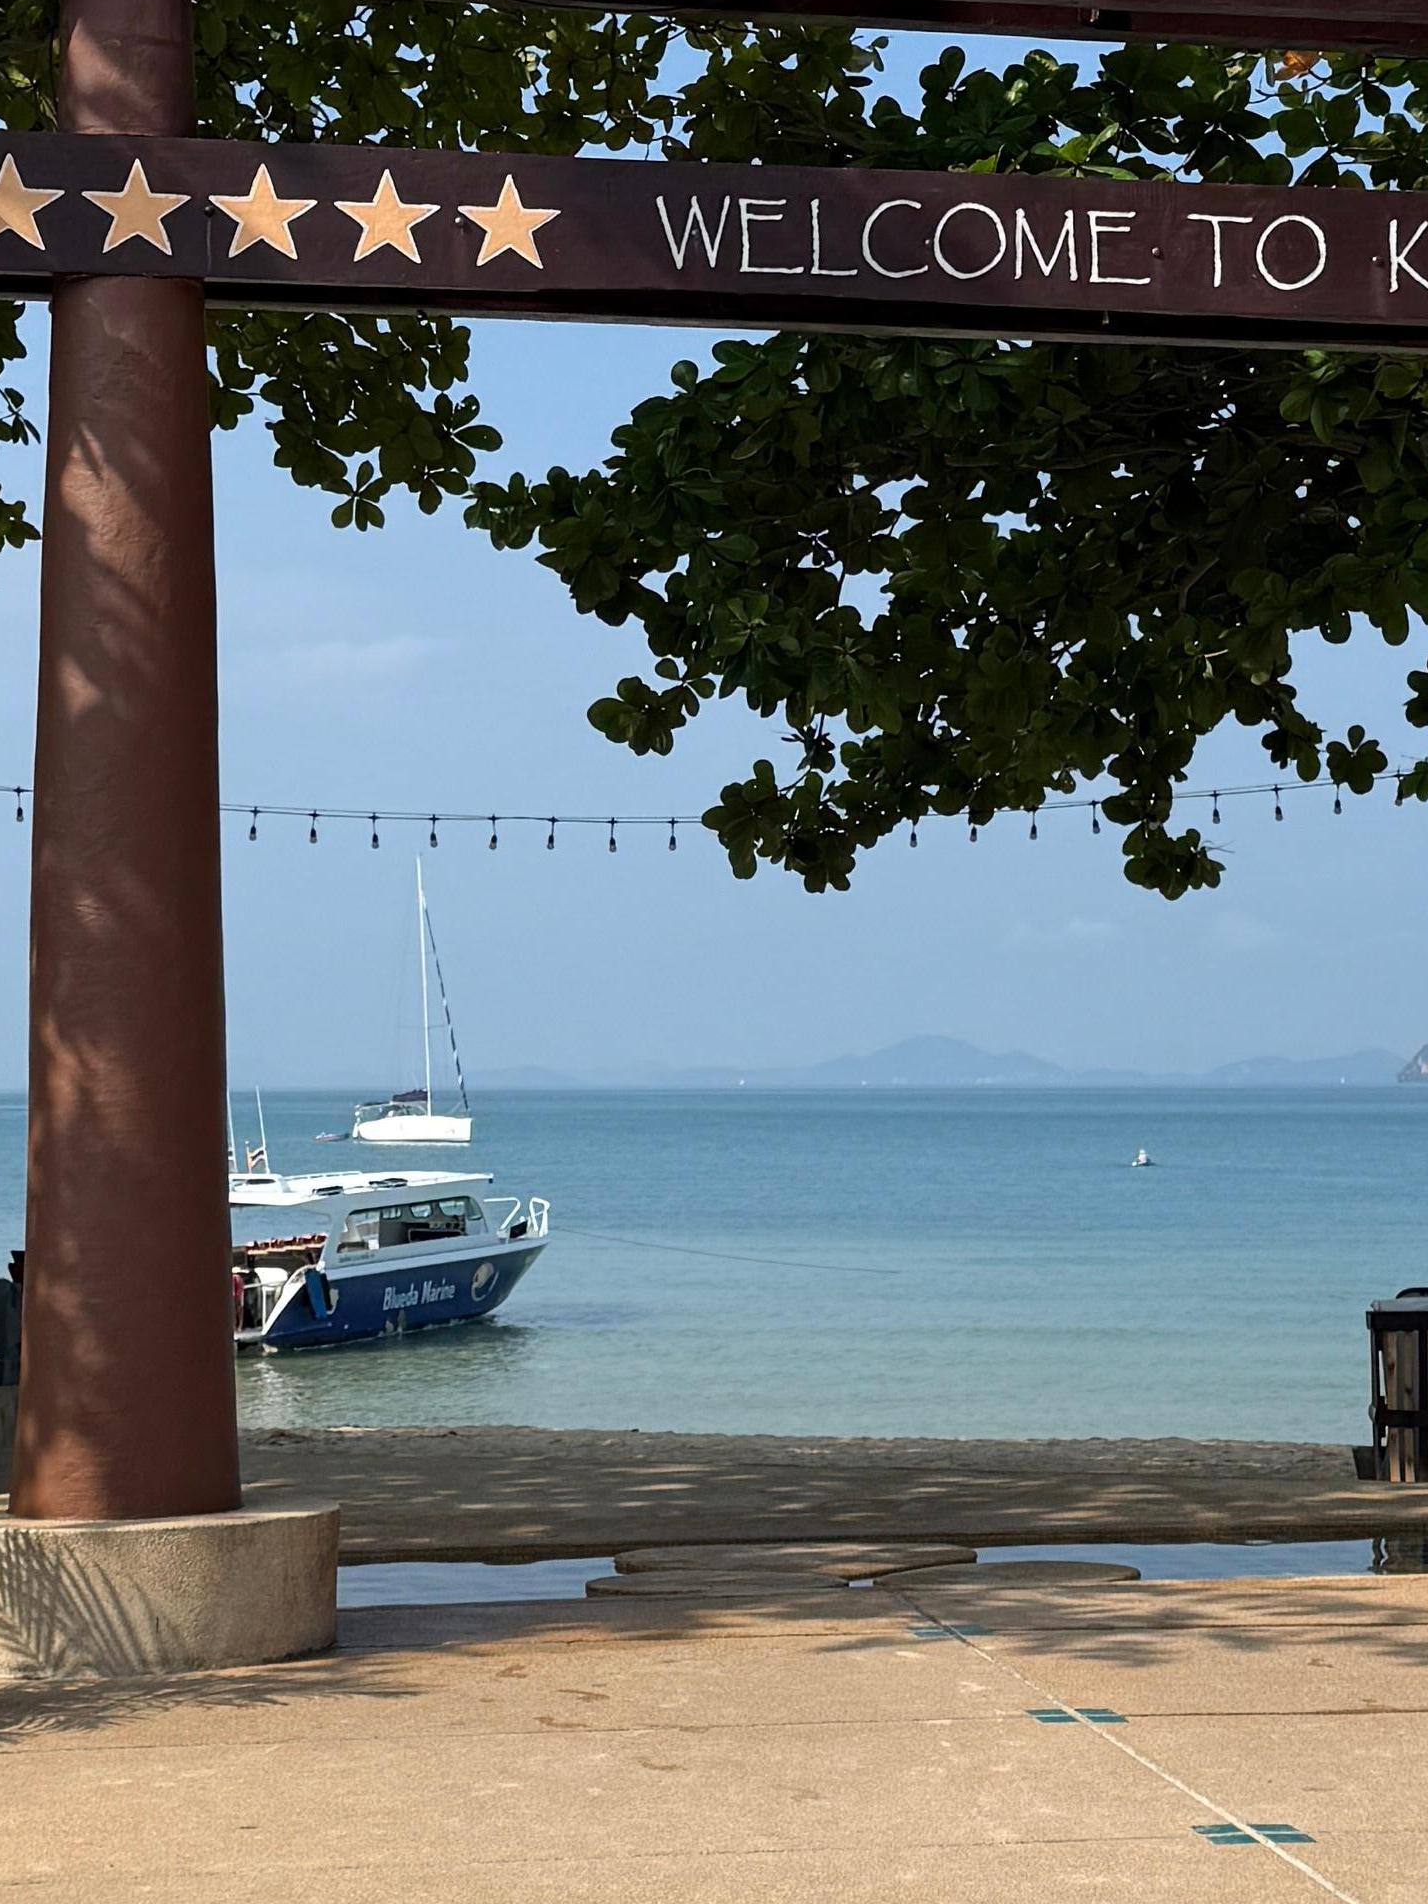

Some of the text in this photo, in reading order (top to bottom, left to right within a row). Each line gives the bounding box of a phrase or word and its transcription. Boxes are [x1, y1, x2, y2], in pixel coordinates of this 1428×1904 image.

[656, 196, 1151, 284] WELCOME
[1187, 214, 1326, 290] TO
[422, 1279, 455, 1303] Marine
